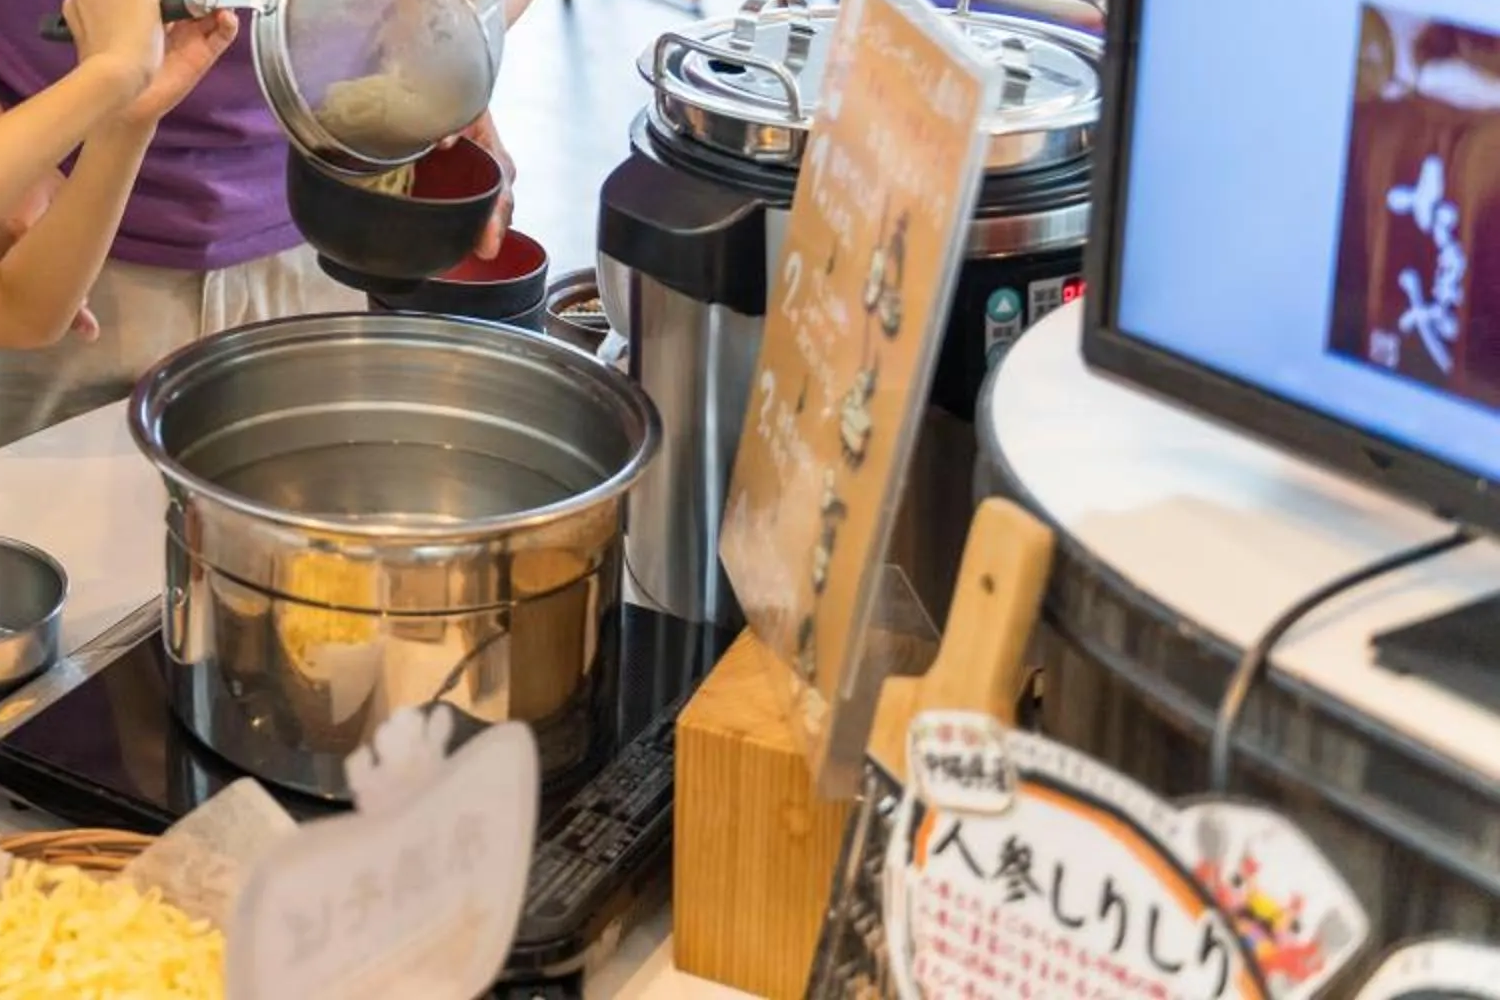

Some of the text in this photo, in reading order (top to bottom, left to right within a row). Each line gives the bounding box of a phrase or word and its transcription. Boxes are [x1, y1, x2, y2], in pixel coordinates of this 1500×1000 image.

[932, 819, 1230, 999] 人参しりしり
